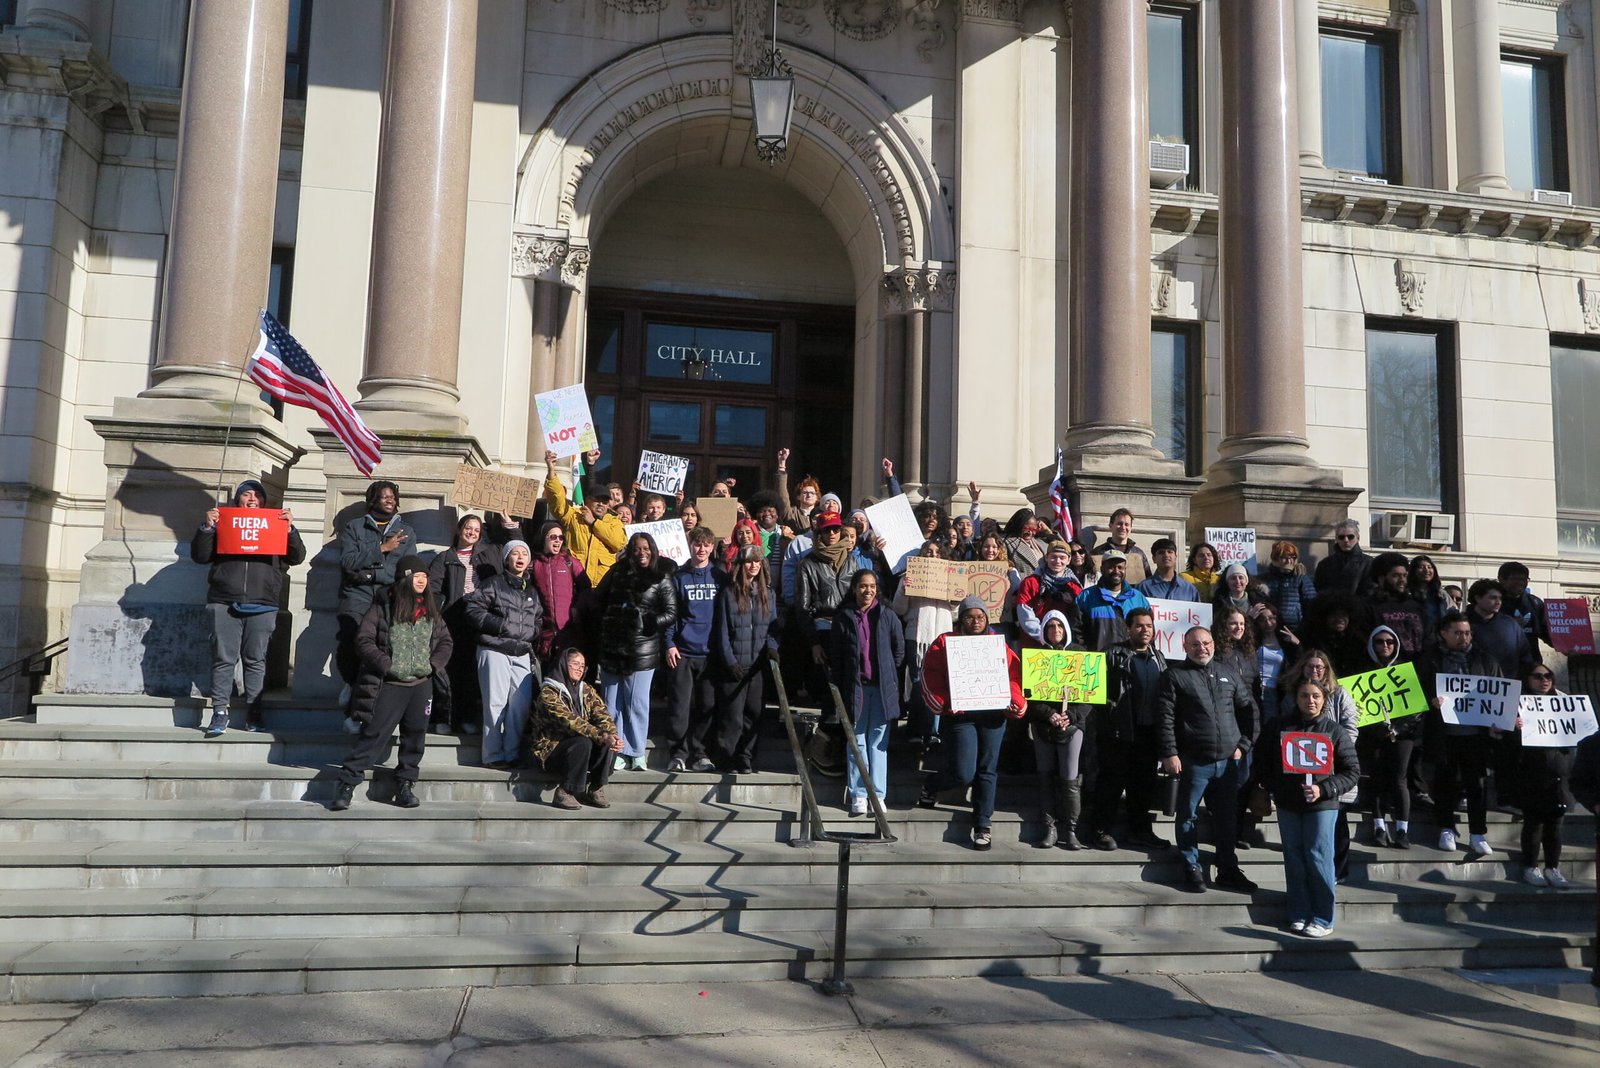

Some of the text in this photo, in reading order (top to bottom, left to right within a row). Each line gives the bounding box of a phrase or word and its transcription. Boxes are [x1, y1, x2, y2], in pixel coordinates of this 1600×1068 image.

[657, 345, 761, 366] CITY HALL
[548, 426, 577, 444] NOT
[644, 452, 689, 469] IMMIGRANTS
[650, 462, 672, 475] BUILT
[459, 465, 539, 492] IMMIGRANTS ARE
[639, 471, 681, 494] AMERICA
[452, 484, 532, 514] ABOLISH ICE
[484, 481, 534, 499] BACKBONE!
[232, 517, 269, 529] FUERA
[241, 529, 260, 541] ICE
[1216, 542, 1244, 551] MAKE
[688, 589, 717, 600] GOLF
[973, 580, 997, 603] ICE
[1150, 604, 1179, 622] THIS
[1546, 602, 1568, 610] ICE IS
[1549, 618, 1588, 626] WELCOME
[1551, 626, 1570, 634] HERE
[1351, 667, 1407, 702] ICE
[1445, 677, 1511, 697] ICE OUT
[1366, 688, 1411, 716] OUT
[1454, 697, 1505, 717] OF NJ
[1550, 697, 1587, 713] OUT
[1537, 718, 1577, 735] NOW
[1286, 740, 1328, 767] ICE
